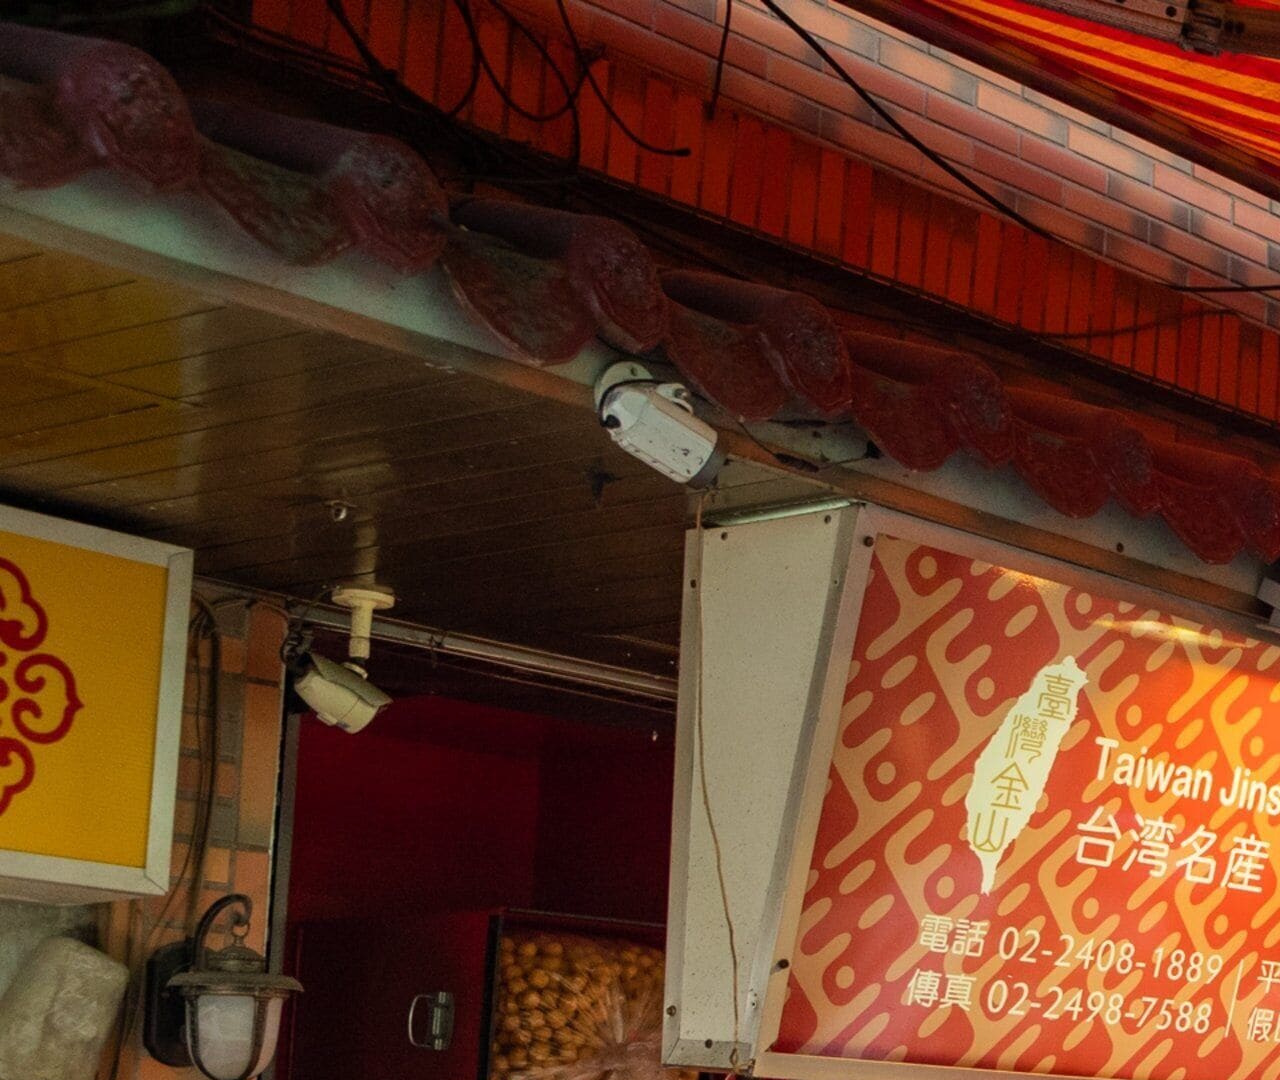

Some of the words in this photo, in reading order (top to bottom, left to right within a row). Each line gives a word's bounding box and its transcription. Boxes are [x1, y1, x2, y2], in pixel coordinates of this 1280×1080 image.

[1095, 736, 1213, 802] Taiwan
[1076, 806, 1271, 894] 台湾名産
[919, 914, 989, 957] 電話
[999, 926, 1223, 984] 02-2408-1889
[906, 968, 976, 1011] 傳真
[987, 980, 1212, 1034] 02-2498-7588
